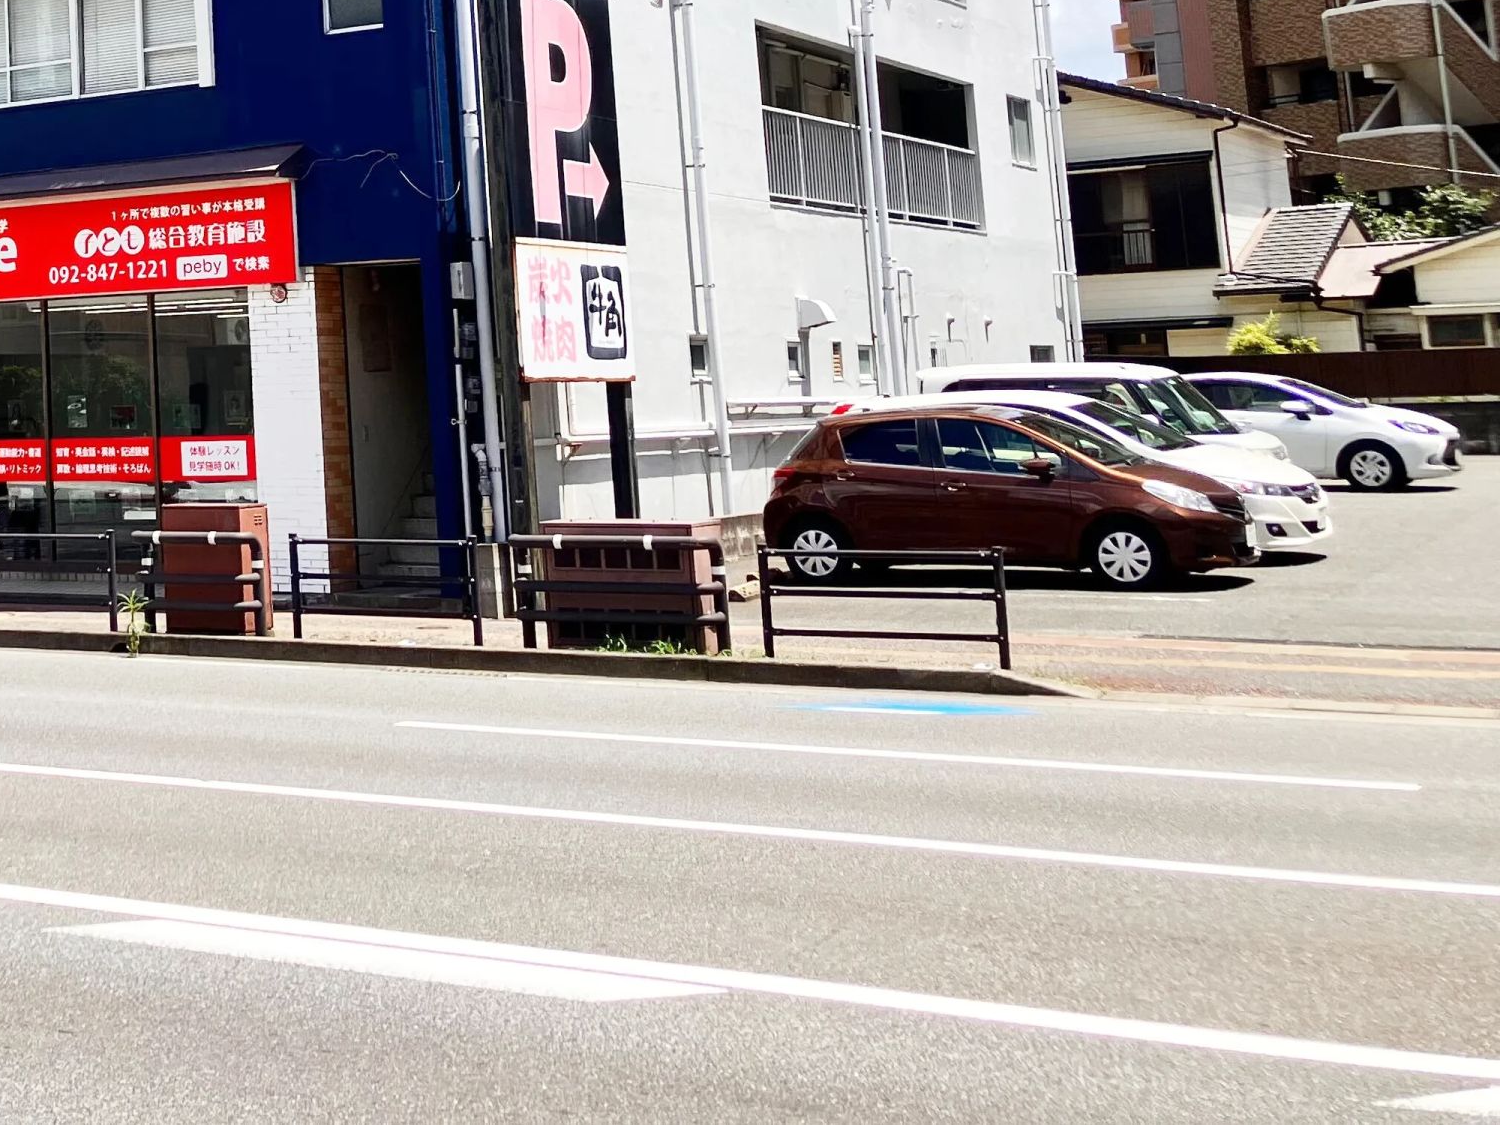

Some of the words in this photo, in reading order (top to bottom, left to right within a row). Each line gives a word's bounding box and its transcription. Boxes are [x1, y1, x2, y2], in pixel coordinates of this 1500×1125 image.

[149, 219, 266, 250] 総合教育施設
[49, 259, 167, 284] 092-847-1221
[183, 259, 222, 276] peby
[233, 256, 270, 272] で検索
[528, 255, 573, 305] 炭火
[589, 282, 622, 337] 牛角
[190, 445, 240, 456] 体験レッスン
